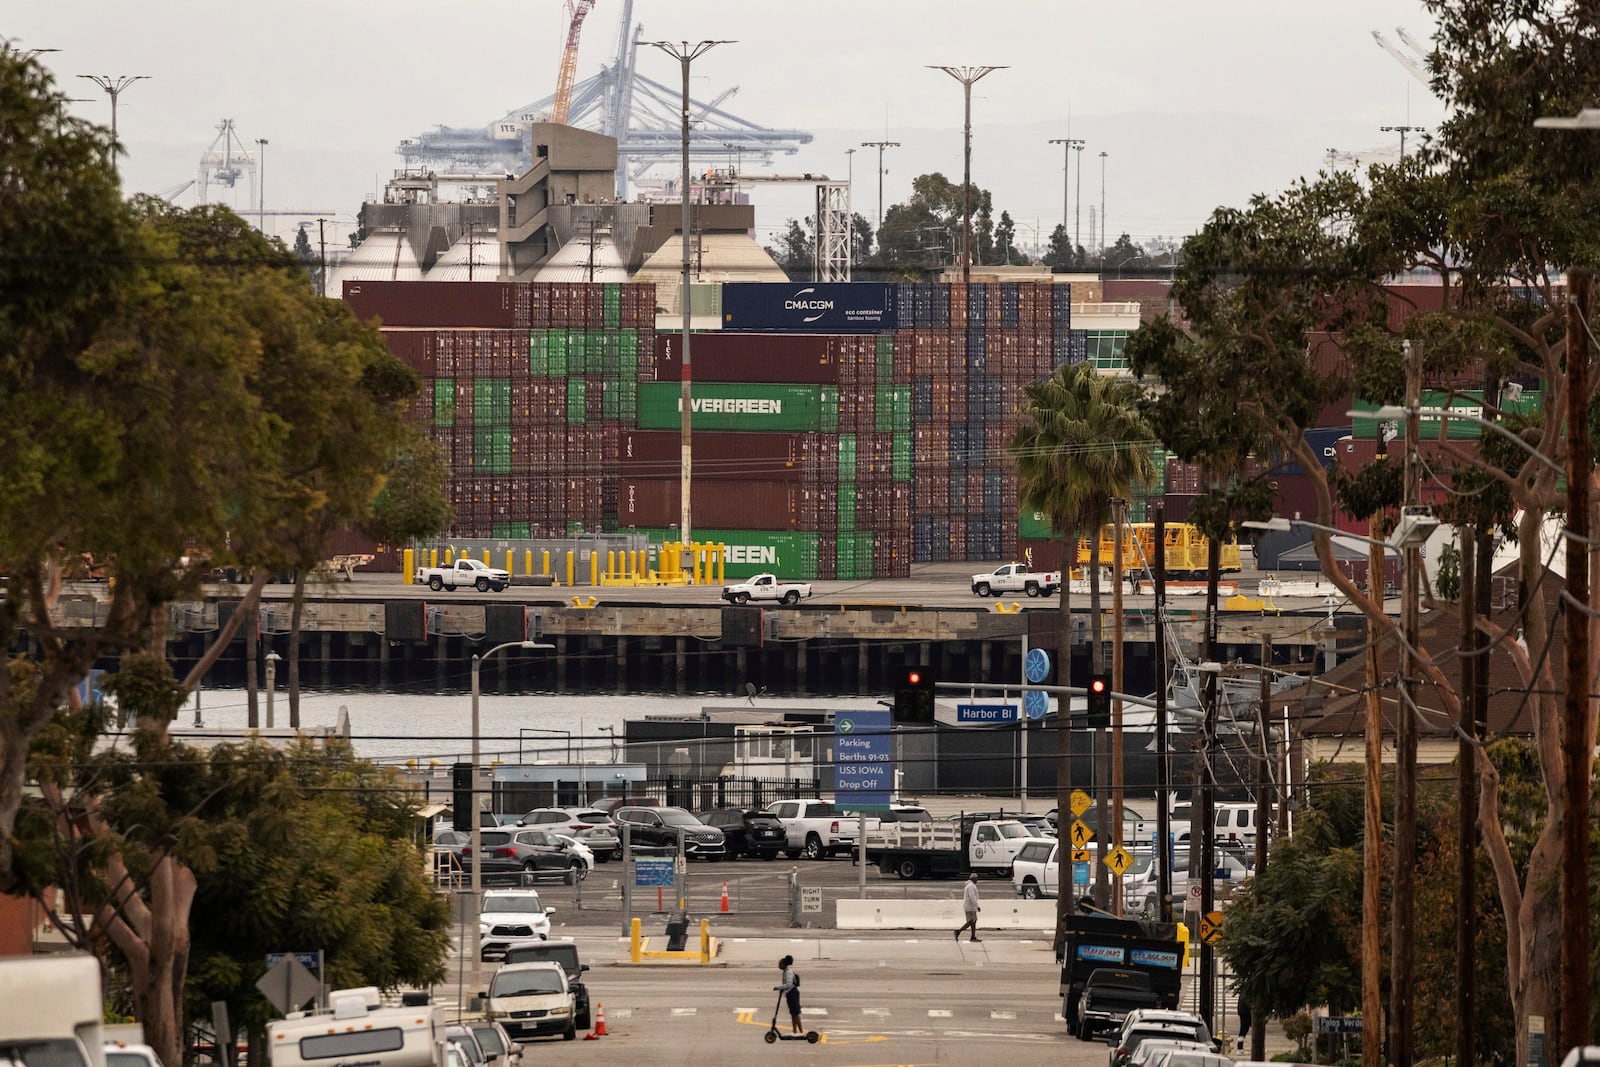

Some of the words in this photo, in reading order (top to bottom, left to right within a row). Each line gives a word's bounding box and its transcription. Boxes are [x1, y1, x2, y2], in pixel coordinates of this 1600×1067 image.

[500, 124, 516, 132] ITS
[963, 708, 998, 719] Harbor
[1001, 708, 1012, 719] Bl
[839, 738, 871, 749] Parking
[839, 752, 867, 761] Berths
[839, 766, 857, 775] USS
[859, 766, 884, 775] IOWA
[839, 780, 861, 790] Drop
[862, 779, 878, 789] Off
[1321, 1017, 1341, 1026] Palos
